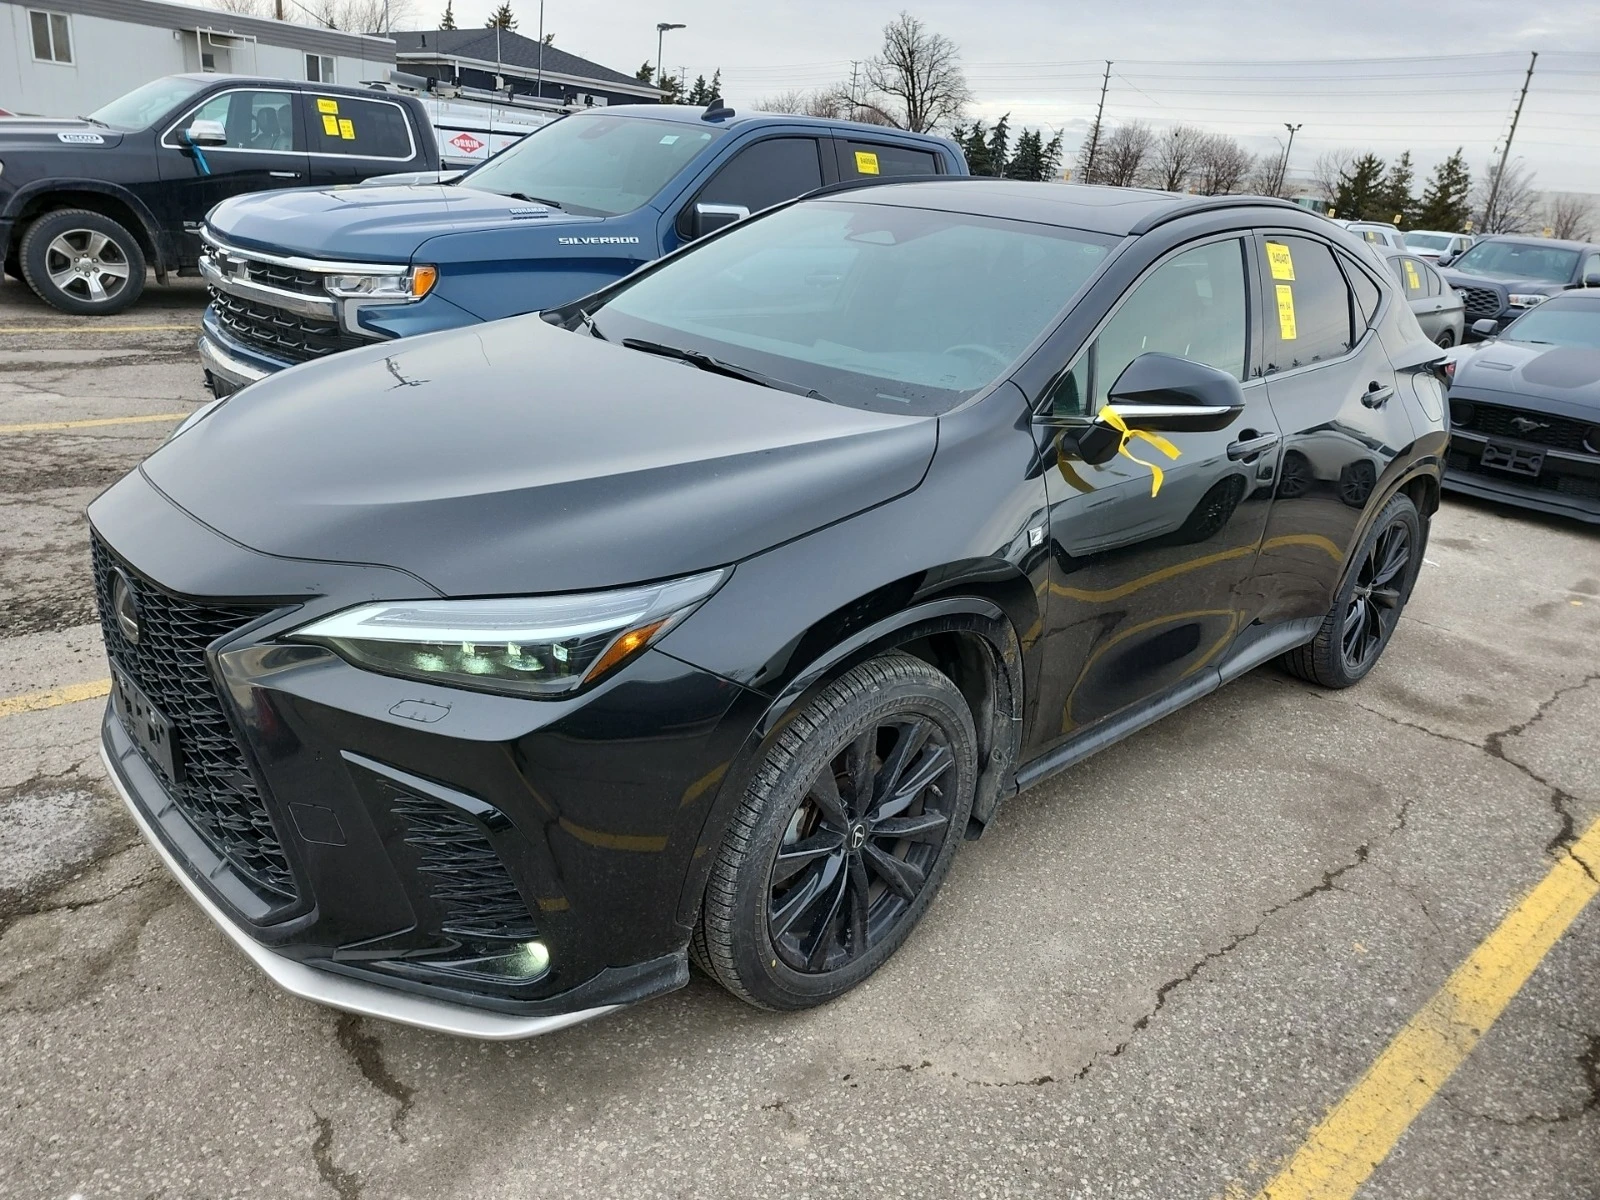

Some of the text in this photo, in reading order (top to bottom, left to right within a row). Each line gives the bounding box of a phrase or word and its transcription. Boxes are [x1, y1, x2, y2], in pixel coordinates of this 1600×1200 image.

[62, 133, 100, 141] 1500
[453, 138, 480, 148] ORKIN
[509, 206, 549, 215] DURAMAX
[558, 236, 640, 246] SILVERADO
